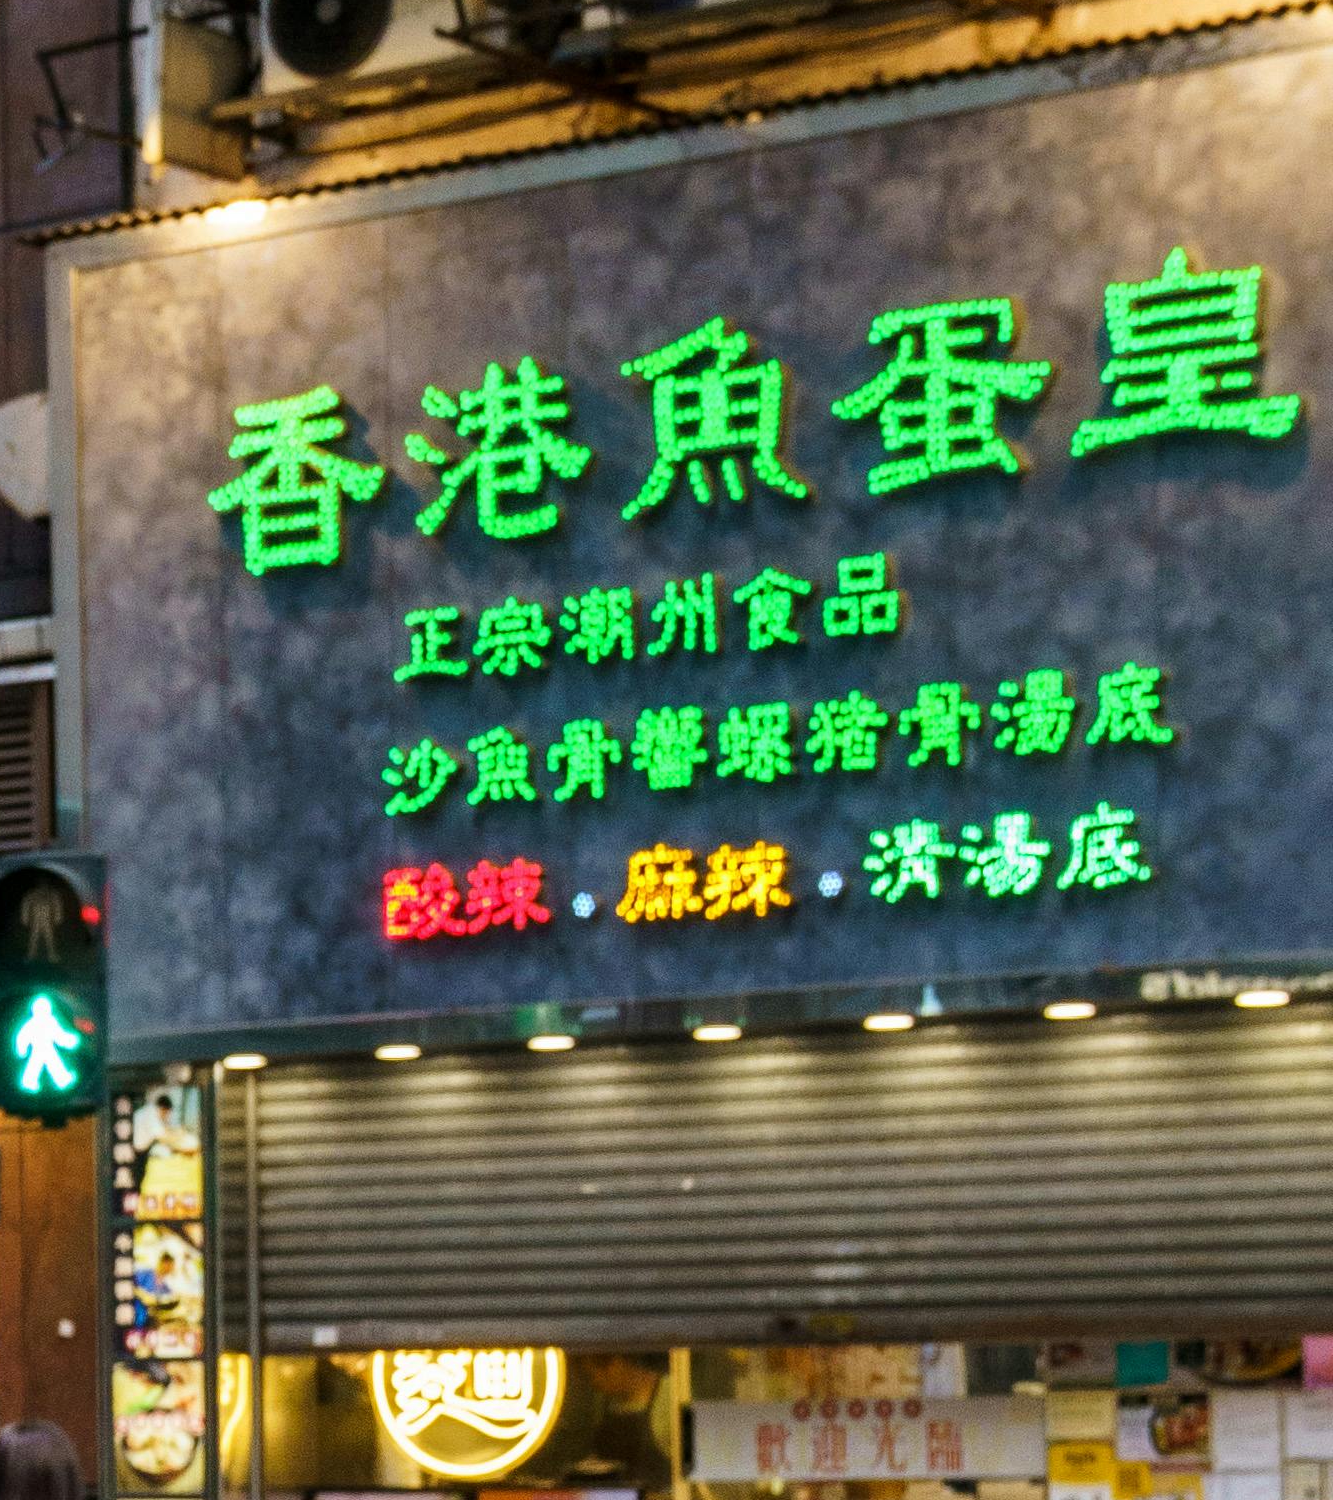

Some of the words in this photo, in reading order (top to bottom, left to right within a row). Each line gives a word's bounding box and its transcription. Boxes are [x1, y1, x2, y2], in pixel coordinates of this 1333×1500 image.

[209, 246, 1302, 577] 香港魚蛋皇
[392, 551, 903, 683] 正宗潮州食品
[754, 1418, 964, 1474] 歡迎光臨
